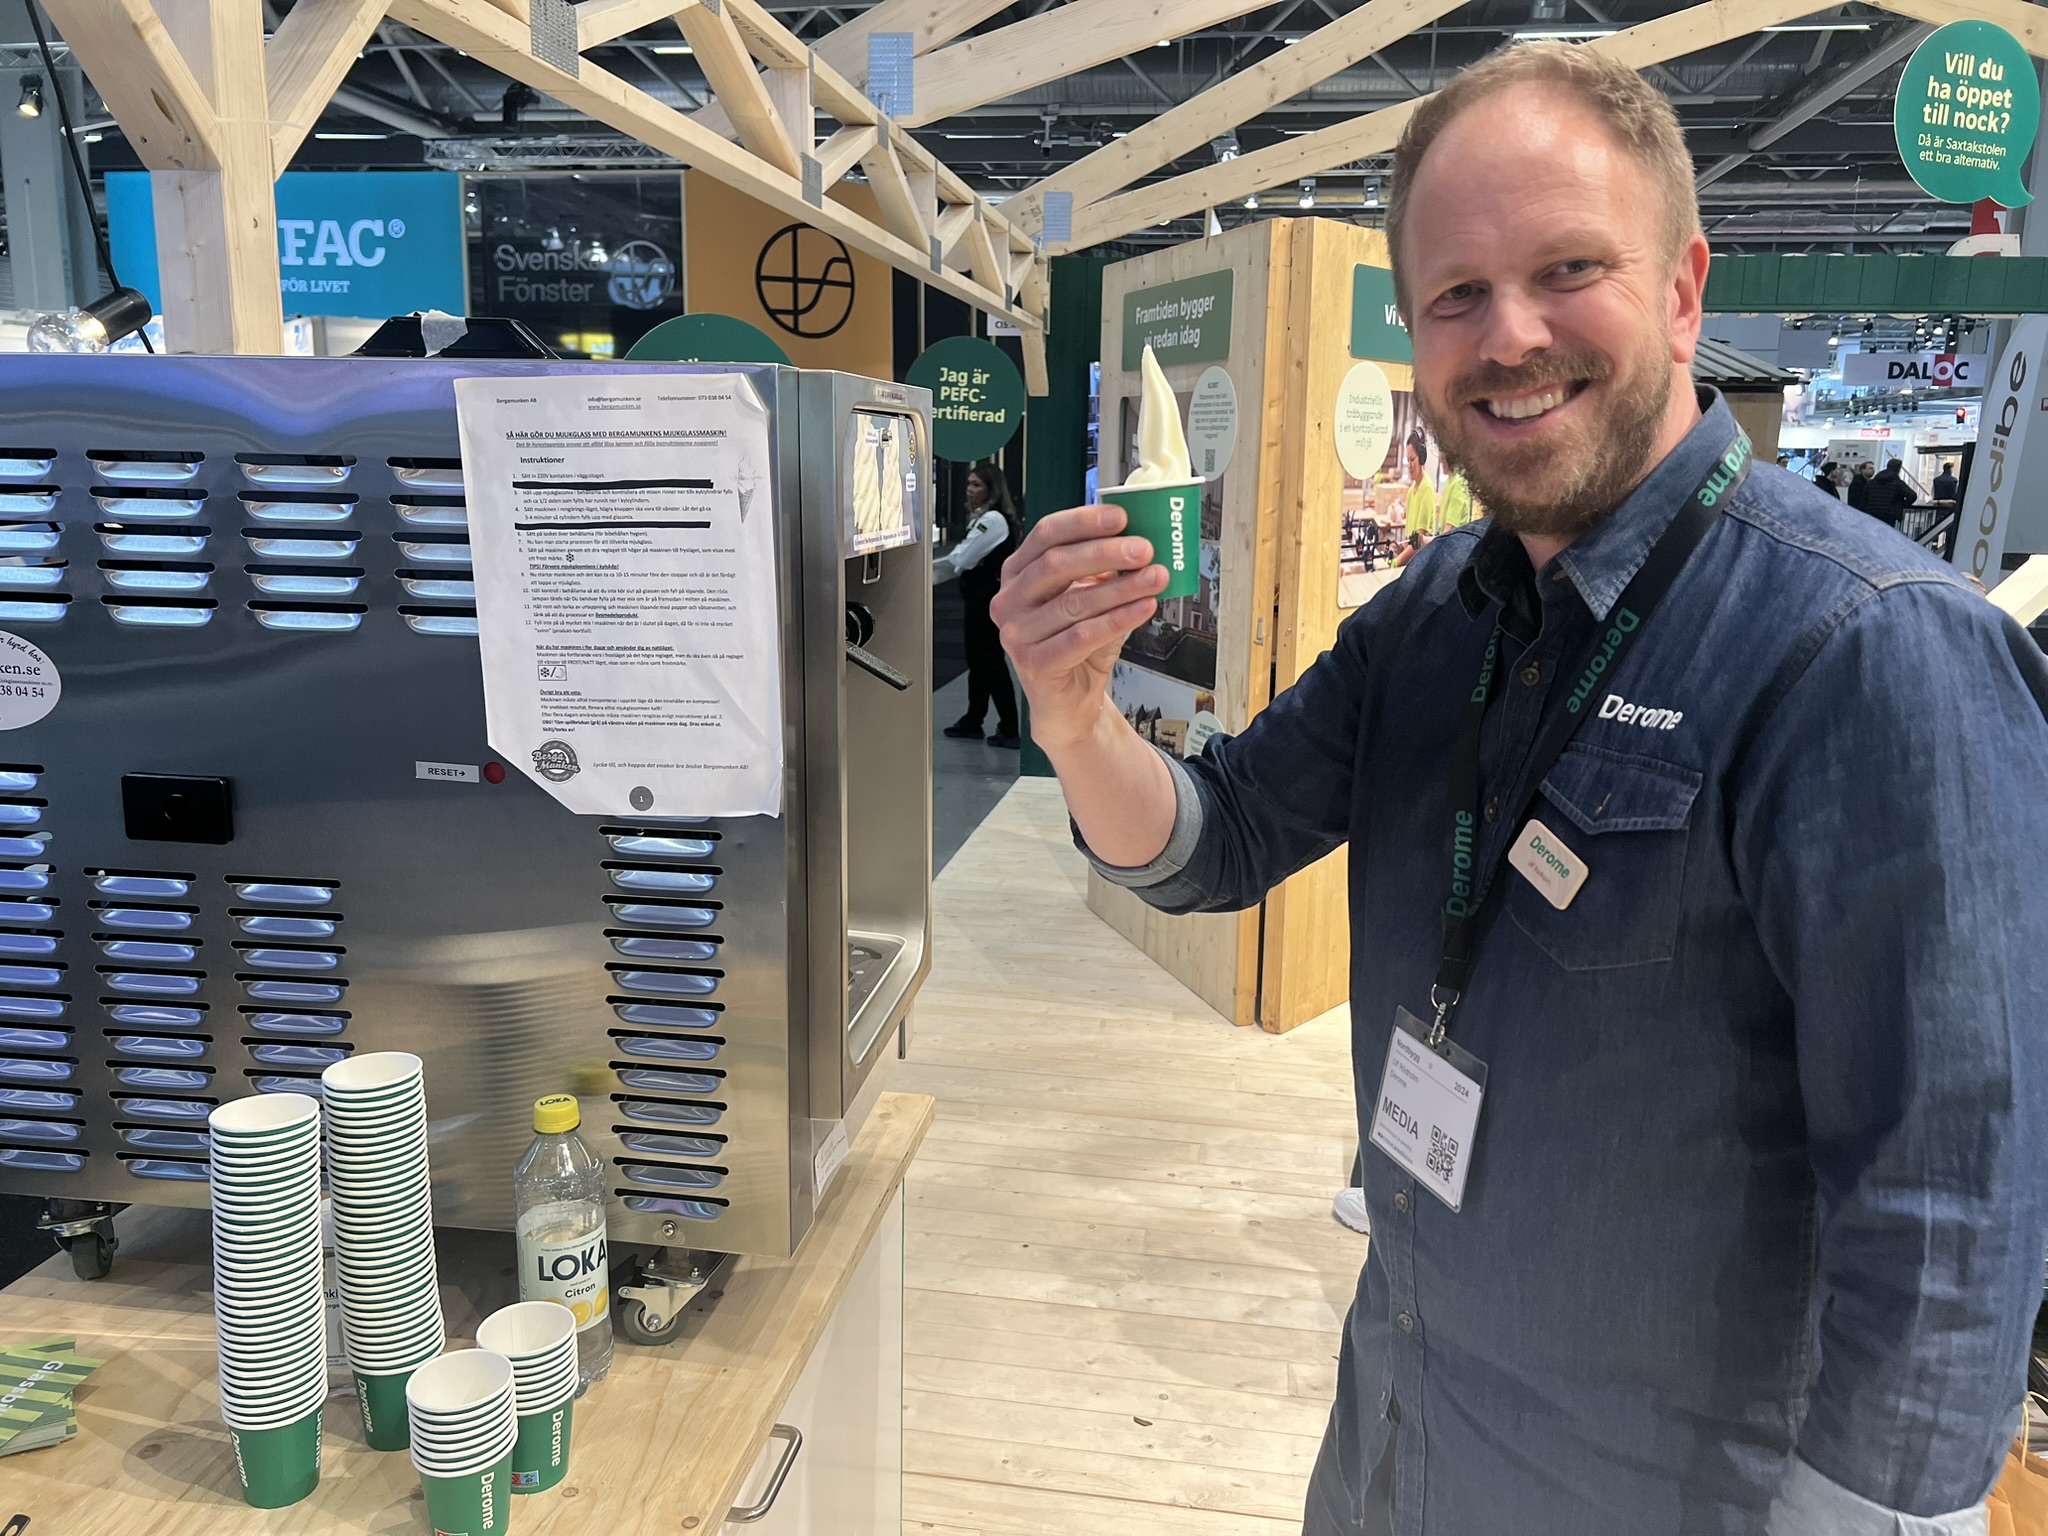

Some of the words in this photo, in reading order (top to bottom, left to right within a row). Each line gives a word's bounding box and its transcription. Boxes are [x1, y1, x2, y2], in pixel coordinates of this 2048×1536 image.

[1945, 52, 1975, 77] Vill
[1979, 57, 2004, 81] du
[1927, 75, 1951, 99] ha
[1956, 79, 2013, 110] öppet
[1923, 102, 1949, 126] till
[1953, 111, 2010, 134] nock?
[1917, 133, 1931, 146] Då
[1934, 136, 1944, 147] är
[1946, 138, 2007, 156] Saxtakstolen
[1920, 150, 1933, 161] ett
[1936, 151, 1951, 163] bra
[1954, 154, 2001, 170] alternativ.
[495, 244, 600, 272] Svenska
[310, 280, 350, 293] LIVET
[499, 275, 593, 303] Fönster
[1135, 301, 1179, 325] Framtiden
[1180, 295, 1215, 321] bygger
[1384, 303, 1397, 325] Vi
[1152, 332, 1179, 349] redan
[1179, 326, 1200, 349] idag
[940, 368, 967, 387] Jag
[973, 368, 990, 385] är
[1887, 360, 1970, 381] DALOC
[940, 386, 988, 402] PEFC-
[608, 430, 662, 438] BERGAMUNKENS
[663, 429, 727, 437] MJUKGLASSMASKIN!
[1169, 497, 1184, 571] Derome
[7, 637, 28, 652] hyrd
[28, 649, 45, 664] hos:
[1566, 607, 1640, 713] Derome
[15, 686, 28, 697] 04
[31, 687, 44, 698] 54
[1597, 693, 1684, 730] Derome
[428, 768, 459, 777] RESET
[1446, 810, 1473, 918] Derome
[1530, 835, 1570, 879] Derome
[540, 1096, 571, 1106] LOKA
[1454, 1081, 1469, 1098] 2024
[1382, 1096, 1419, 1140] MEDIA
[538, 1238, 607, 1281] LOKA
[565, 1283, 596, 1298] Citron
[357, 1378, 373, 1432] Derome
[551, 1410, 563, 1466] Derome
[231, 1431, 248, 1487] Derome
[481, 1471, 495, 1529] Derome
